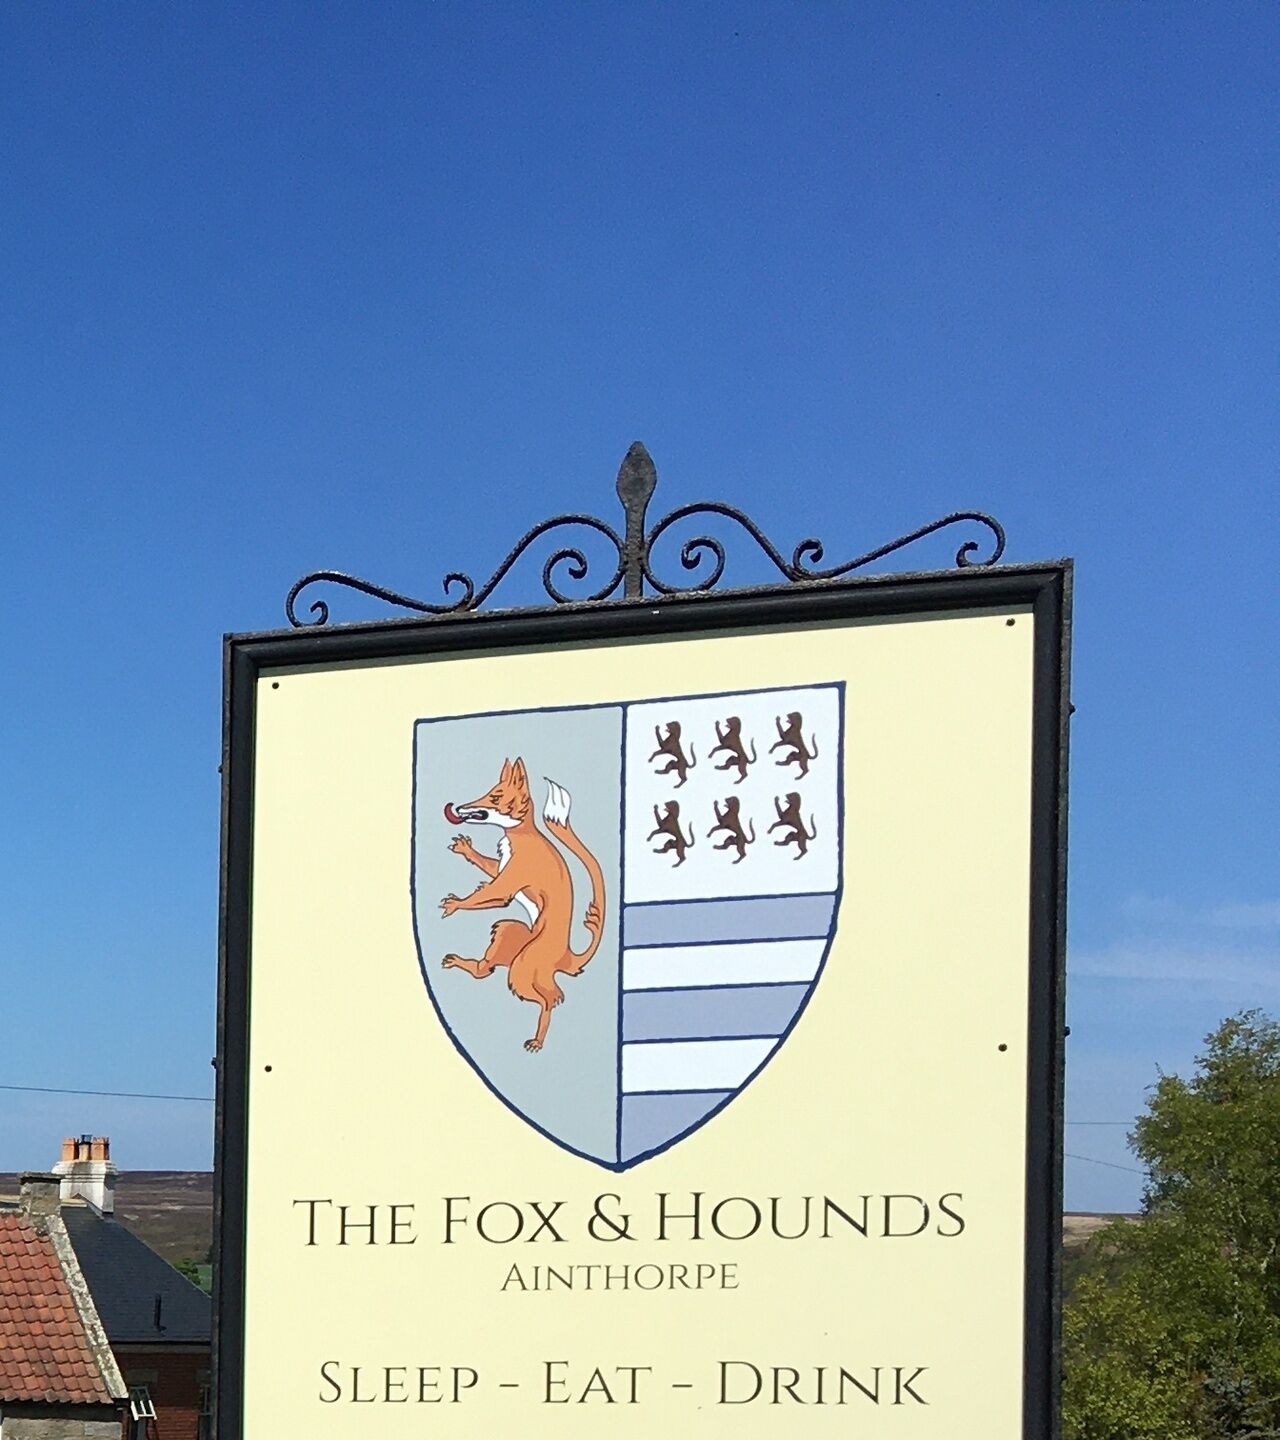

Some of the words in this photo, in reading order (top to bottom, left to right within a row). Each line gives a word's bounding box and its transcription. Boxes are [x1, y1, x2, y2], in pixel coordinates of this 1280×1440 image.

[292, 1198, 417, 1246] THE
[442, 1196, 567, 1244] FOX
[587, 1193, 637, 1242] &
[655, 1191, 966, 1241] HOUNDS
[500, 1263, 740, 1292] AINTHORPE
[319, 1360, 479, 1404] SLEEP
[542, 1360, 653, 1404] EAT
[717, 1361, 930, 1406] DRINK
